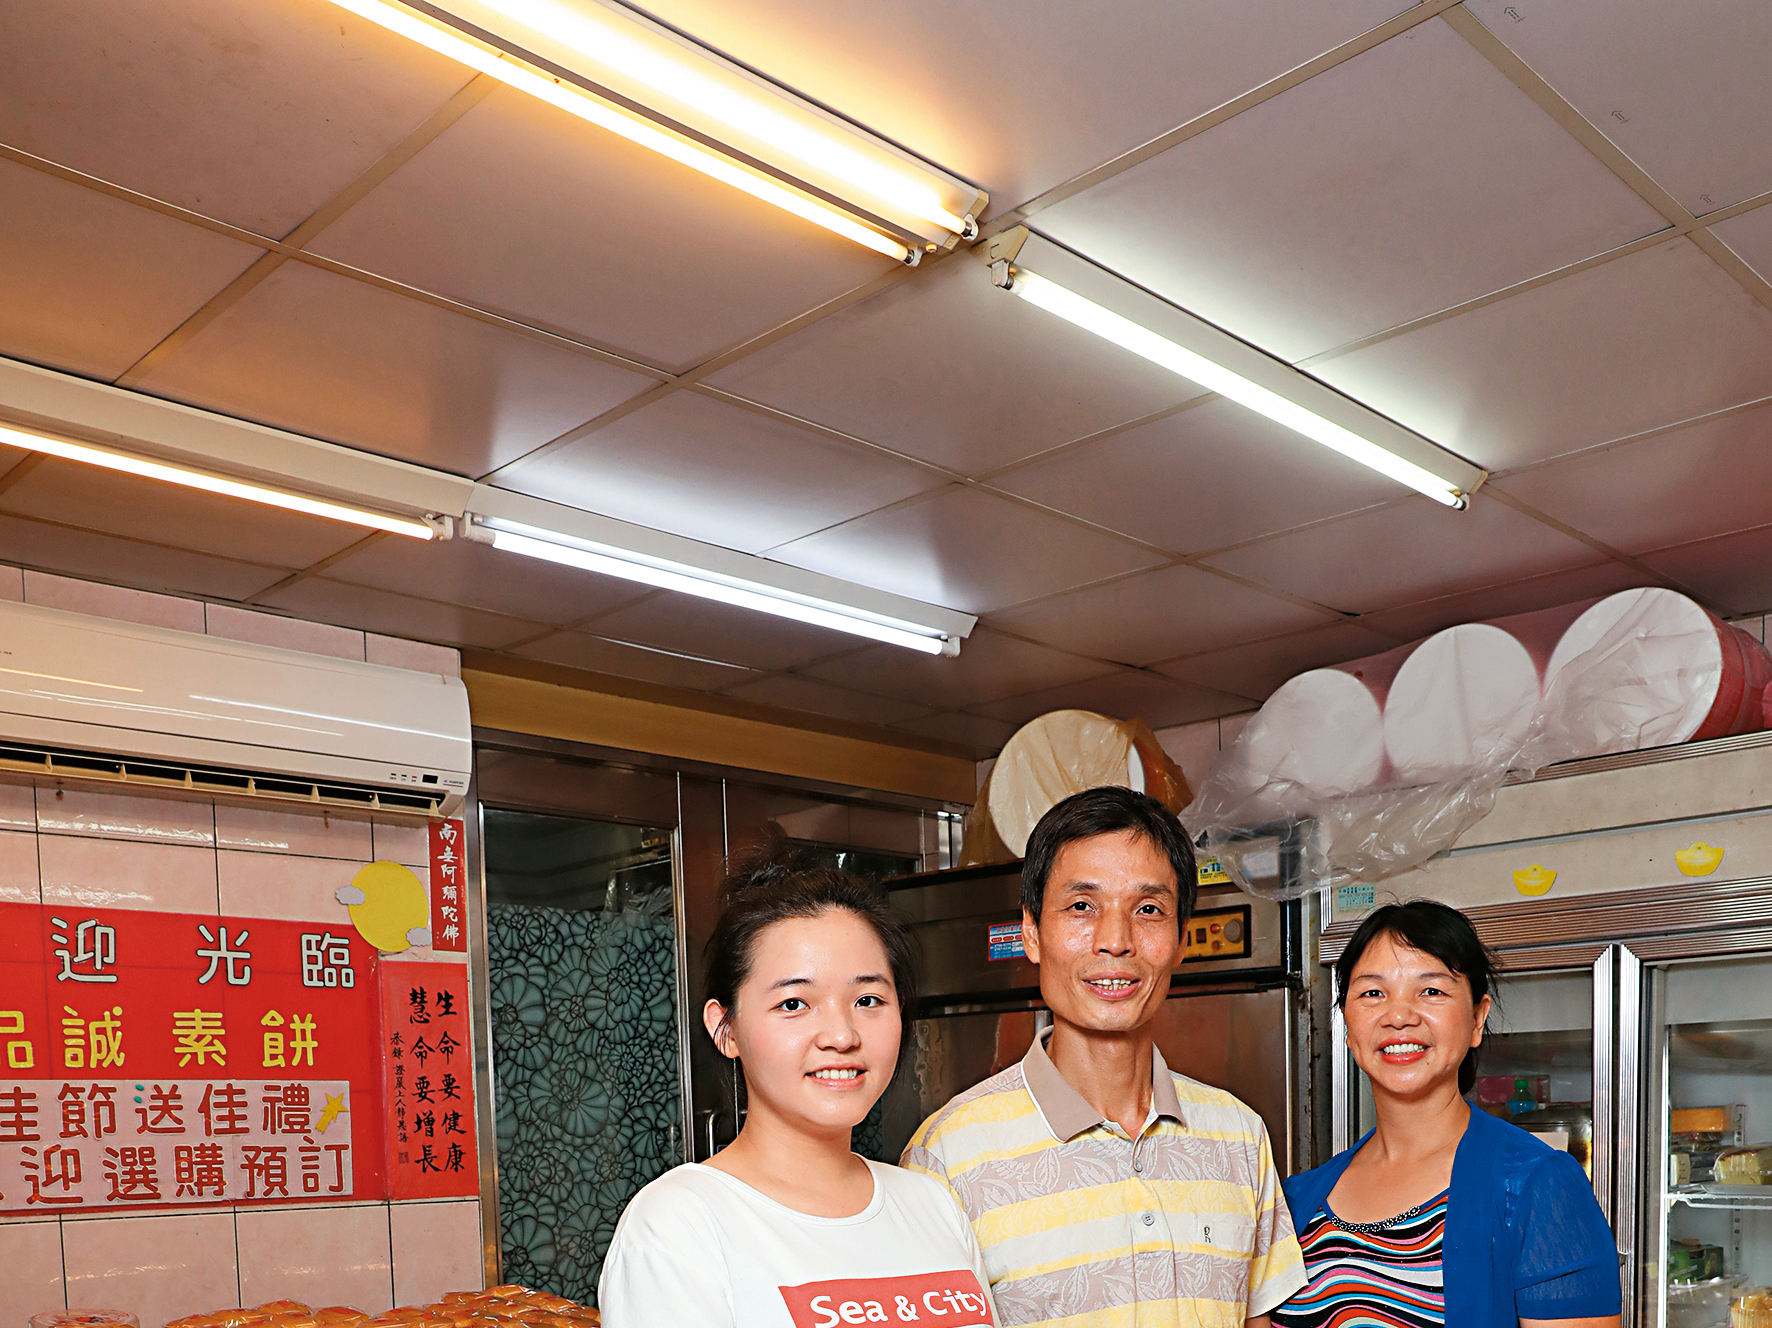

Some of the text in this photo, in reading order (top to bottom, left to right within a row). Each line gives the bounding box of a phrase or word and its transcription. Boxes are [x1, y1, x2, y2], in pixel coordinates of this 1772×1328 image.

[51, 916, 355, 988] 迎光臨
[410, 985, 442, 1173] 慧命要增長
[436, 989, 467, 1173] 生命要健康
[0, 1137, 350, 1205] 迎選購預訂
[894, 1295, 920, 1322] &
[923, 1289, 986, 1316] City
